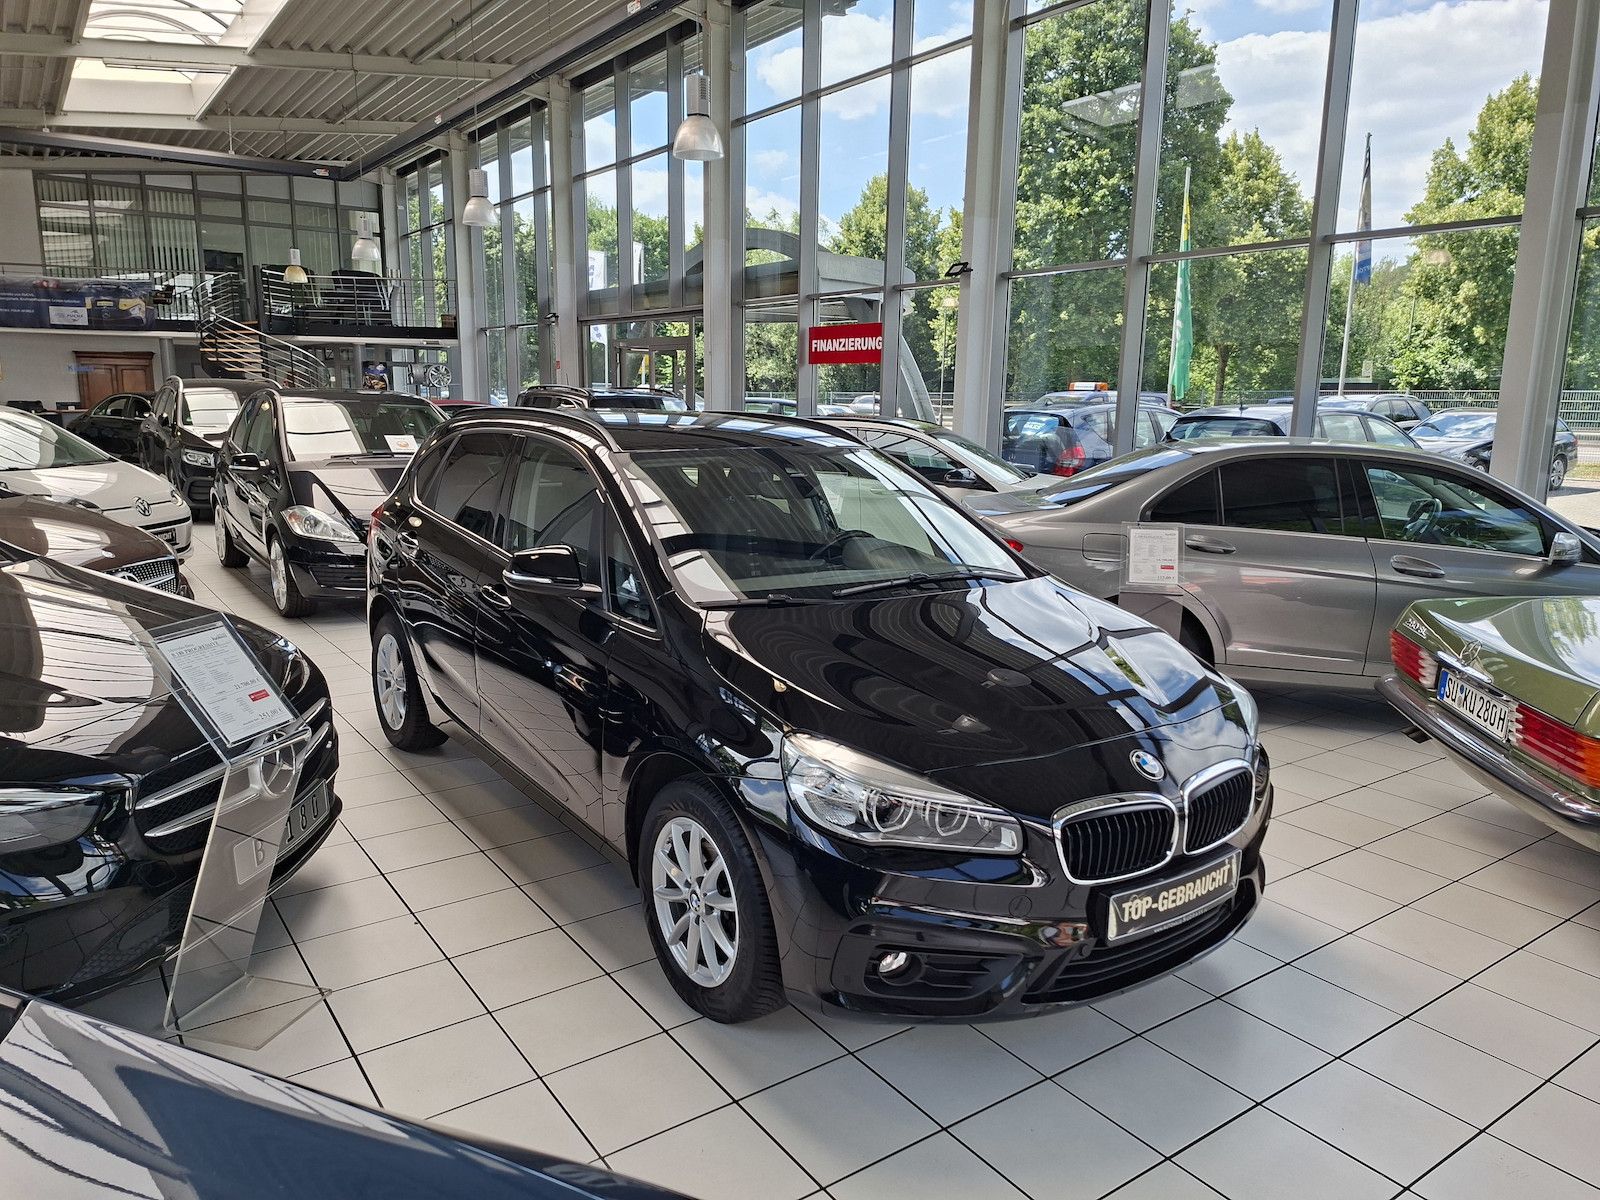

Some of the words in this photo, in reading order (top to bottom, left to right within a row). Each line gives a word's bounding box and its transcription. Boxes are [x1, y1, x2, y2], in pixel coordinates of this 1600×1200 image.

[811, 336, 883, 352] FINANZIERUNG
[1445, 677, 1459, 703] SU
[1462, 687, 1477, 715] KU
[1122, 864, 1230, 923] TOP-GEBRAUCHT
